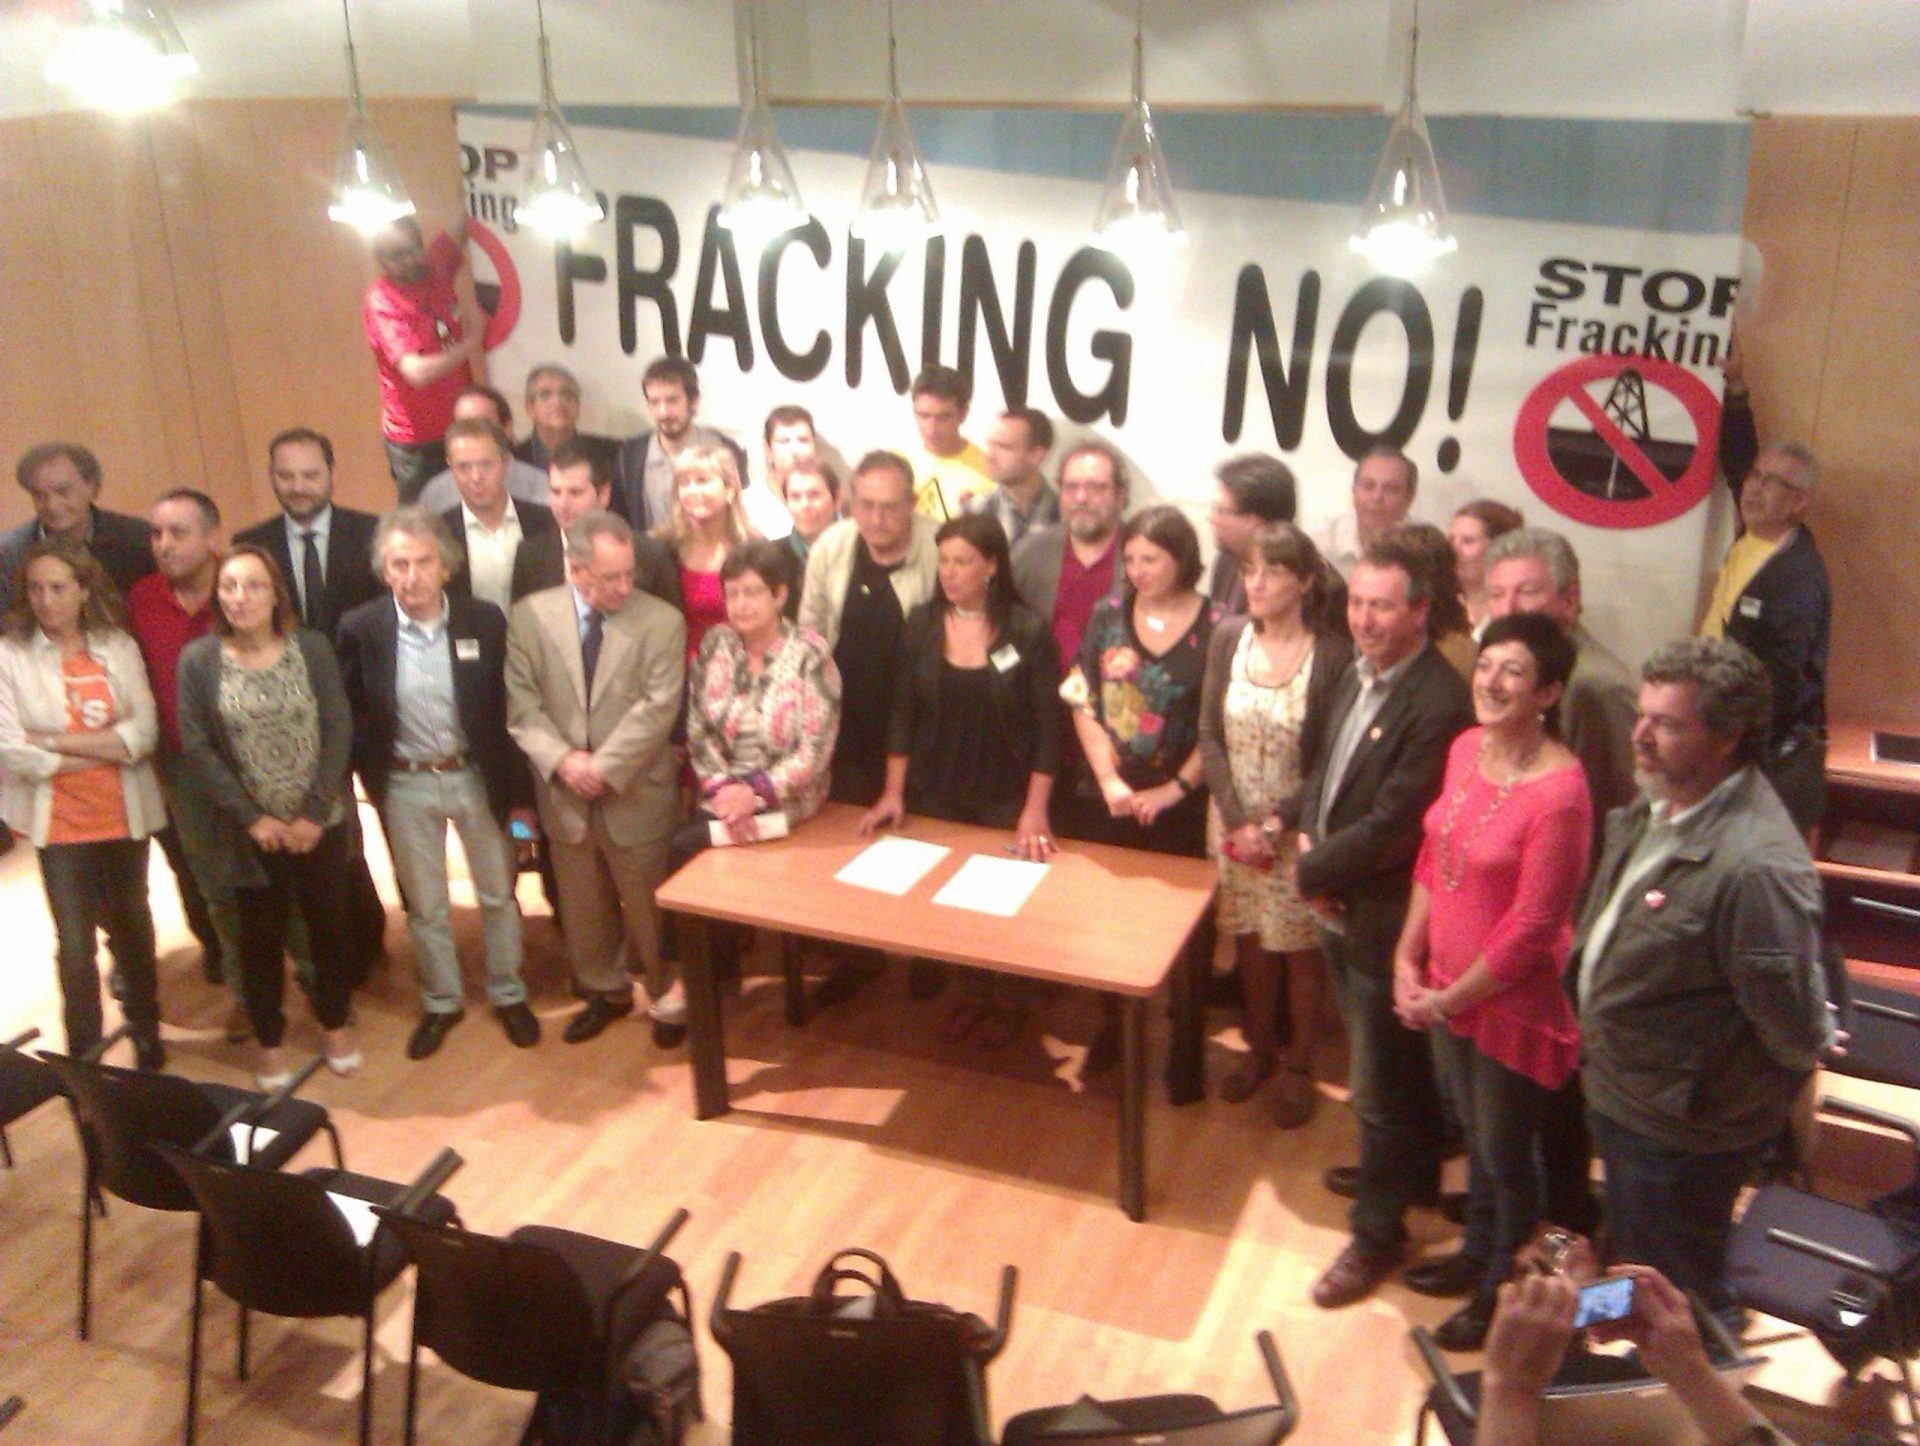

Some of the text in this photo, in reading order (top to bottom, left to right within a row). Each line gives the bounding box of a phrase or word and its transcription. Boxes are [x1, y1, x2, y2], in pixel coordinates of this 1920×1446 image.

[554, 192, 1484, 473] FRACKING NO!
[1526, 303, 1733, 367] Frackin
